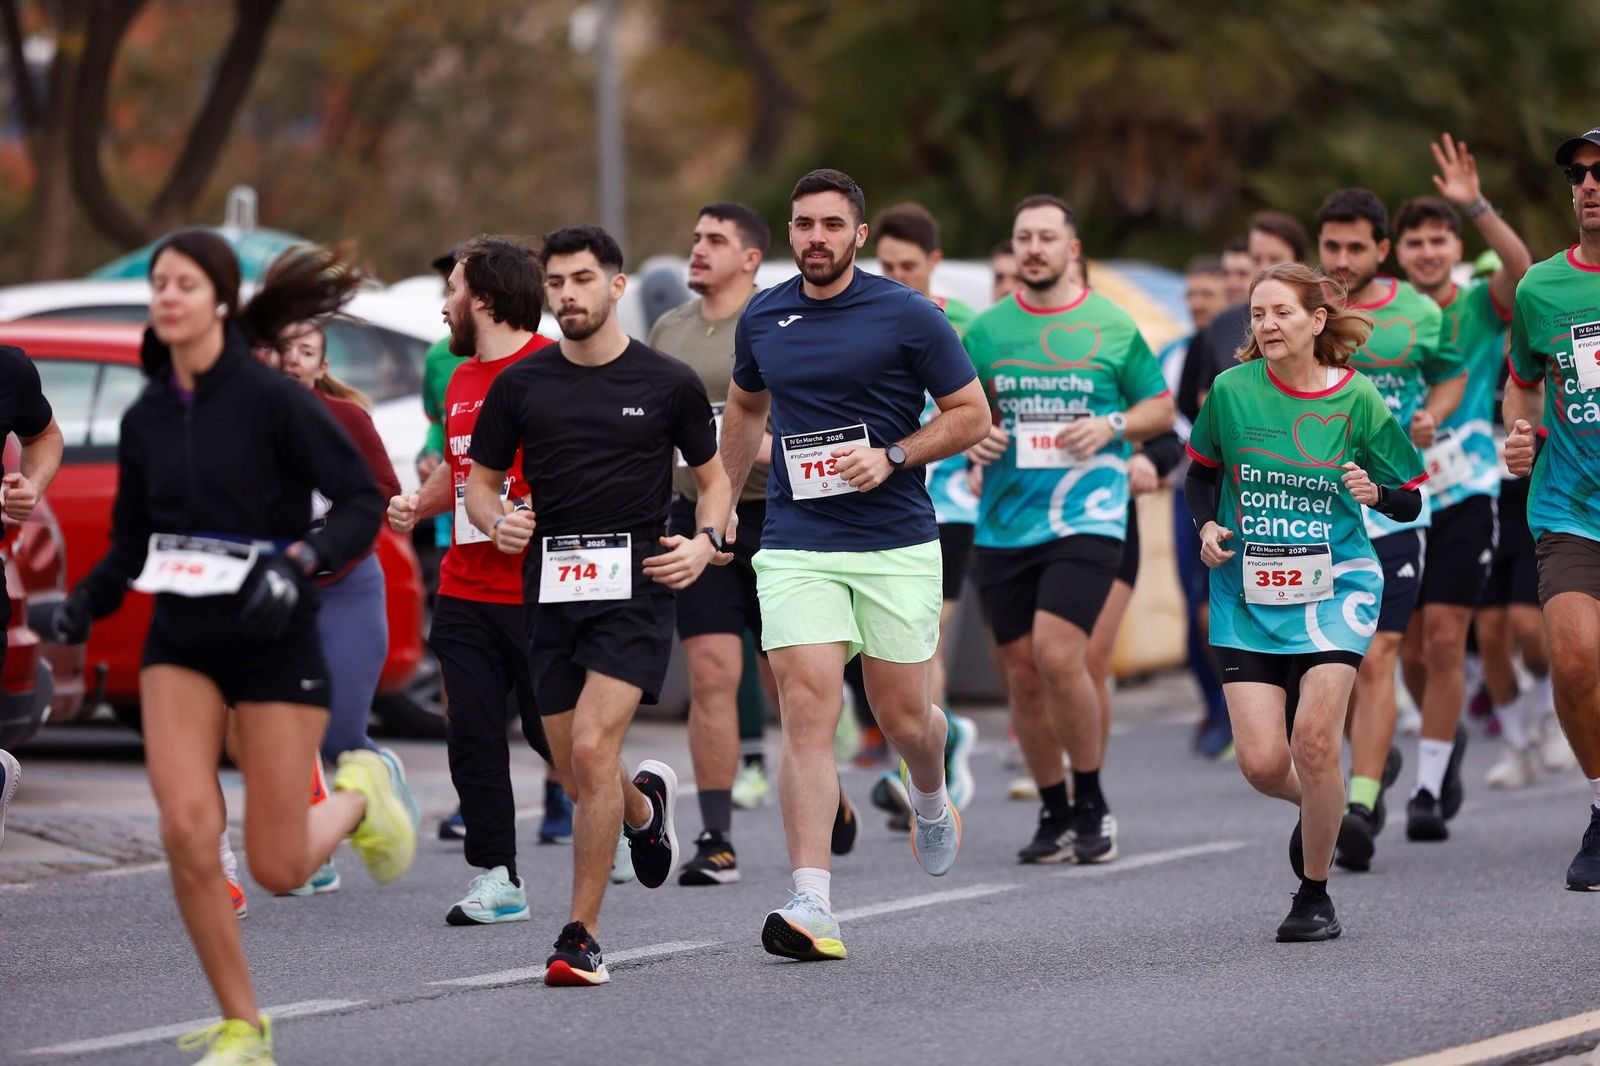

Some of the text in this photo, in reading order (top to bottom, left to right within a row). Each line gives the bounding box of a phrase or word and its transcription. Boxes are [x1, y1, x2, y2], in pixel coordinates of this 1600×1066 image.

[994, 373, 1094, 394] En marcha
[622, 407, 645, 416] FILA
[804, 436, 824, 444] Marcha
[826, 432, 844, 442] 2026
[790, 451, 822, 460] #YoCorroPor
[800, 458, 841, 480] 713
[1240, 464, 1340, 495] En marcha
[1241, 510, 1332, 540] cáncer
[586, 539, 606, 548] 2026
[1288, 546, 1308, 554] 2026
[558, 563, 598, 582] 714
[1255, 570, 1302, 587] 352
